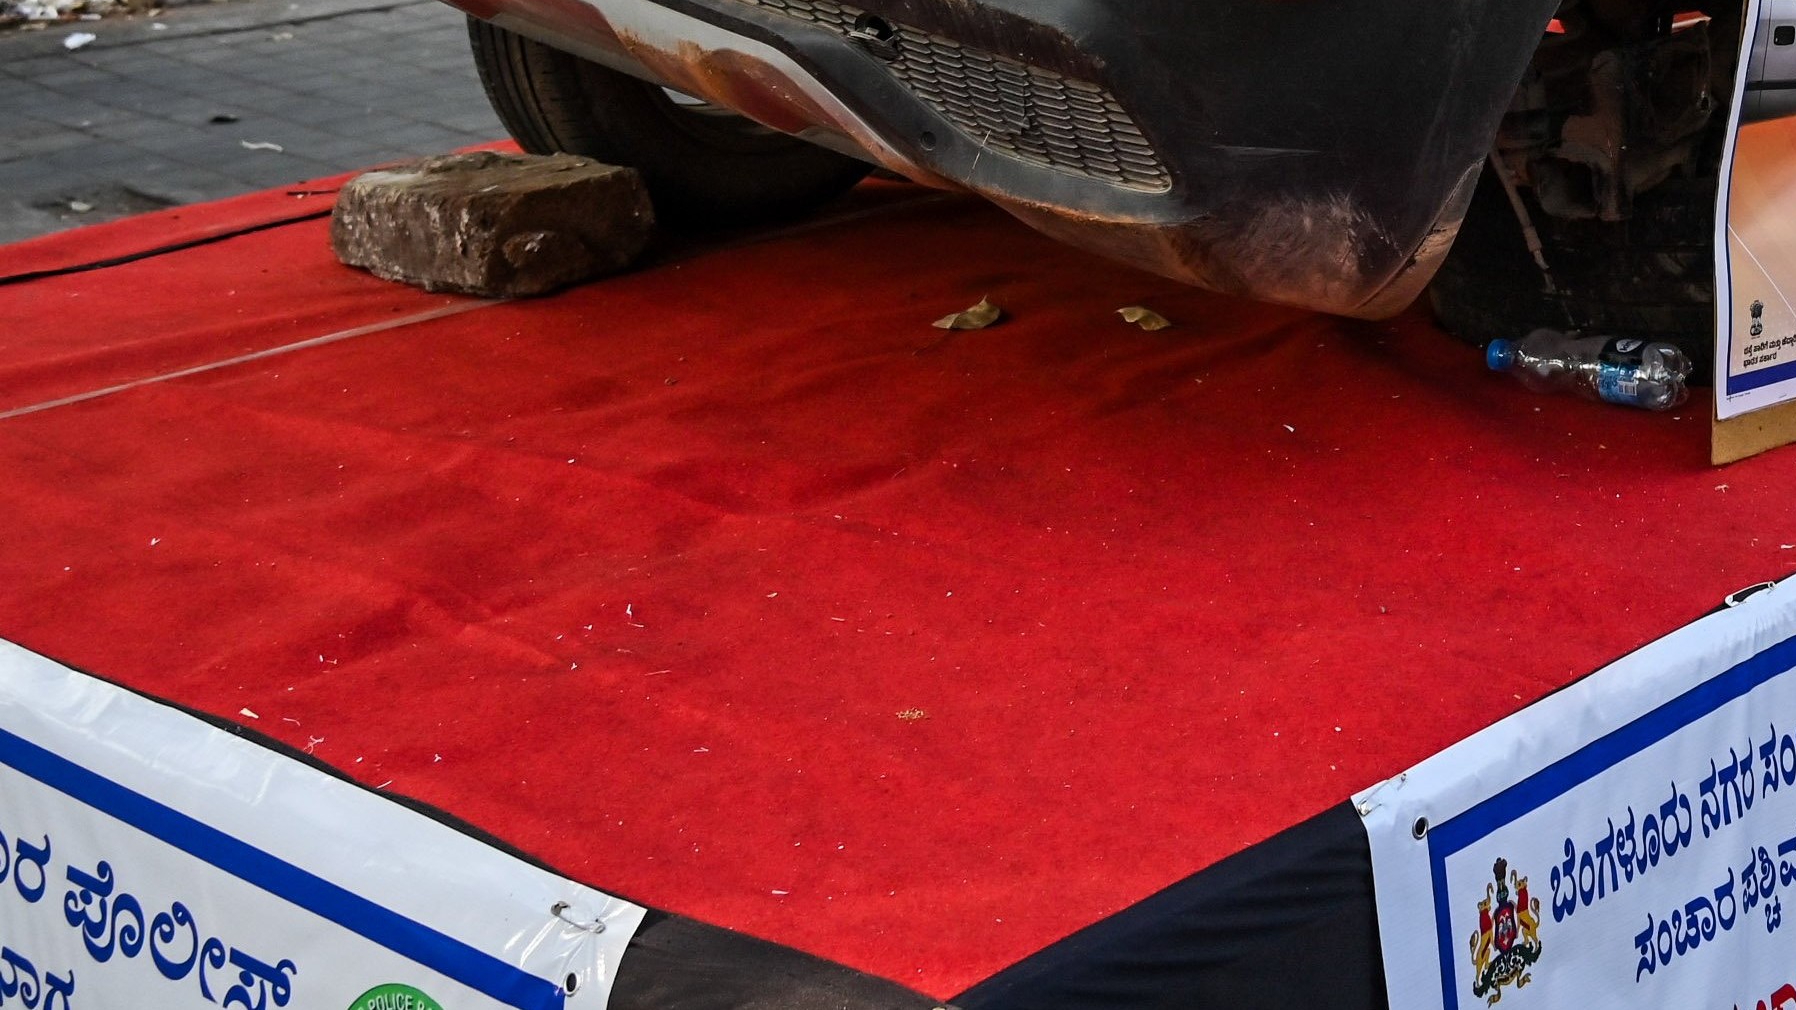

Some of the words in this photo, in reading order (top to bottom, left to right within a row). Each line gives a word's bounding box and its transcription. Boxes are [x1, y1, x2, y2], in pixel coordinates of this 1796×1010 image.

[1550, 780, 1693, 923] ಬೆಂಗಳೂರು
[1700, 736, 1757, 840] ನಗರ
[64, 860, 297, 1010] ಪೊಲೀಸ್
[1634, 867, 1736, 984] ಸಂಚಾರ
